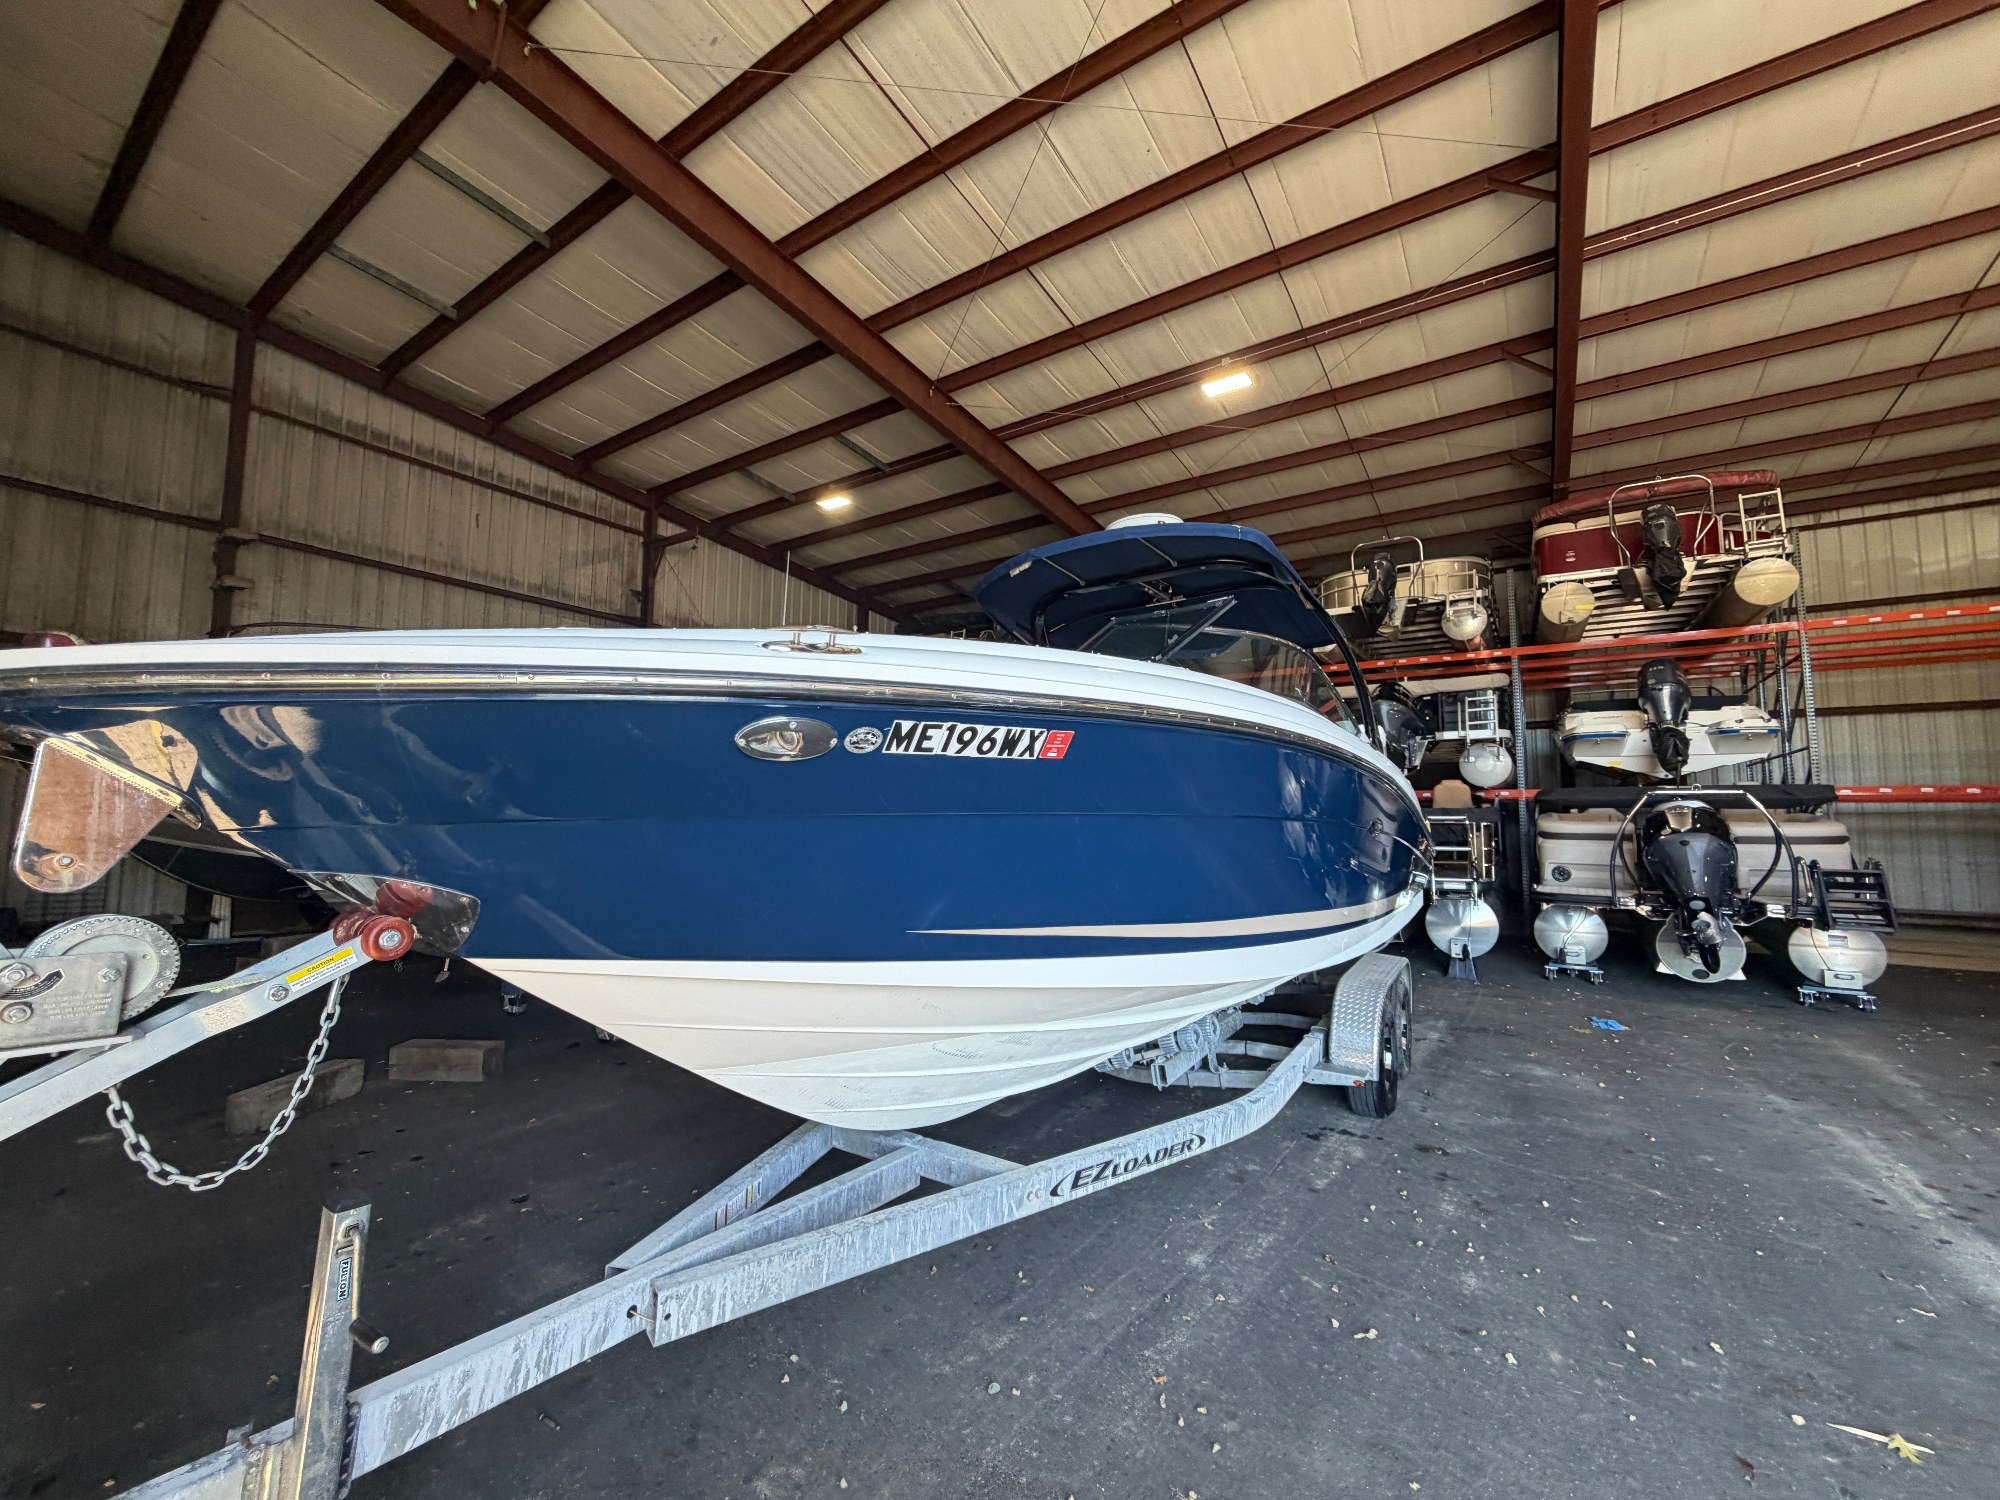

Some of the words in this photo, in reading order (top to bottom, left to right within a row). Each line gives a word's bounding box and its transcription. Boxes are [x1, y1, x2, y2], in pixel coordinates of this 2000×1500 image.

[885, 721, 1046, 758] ME196WX
[307, 957, 335, 972] CAUTION
[338, 1260, 349, 1298] FULTON
